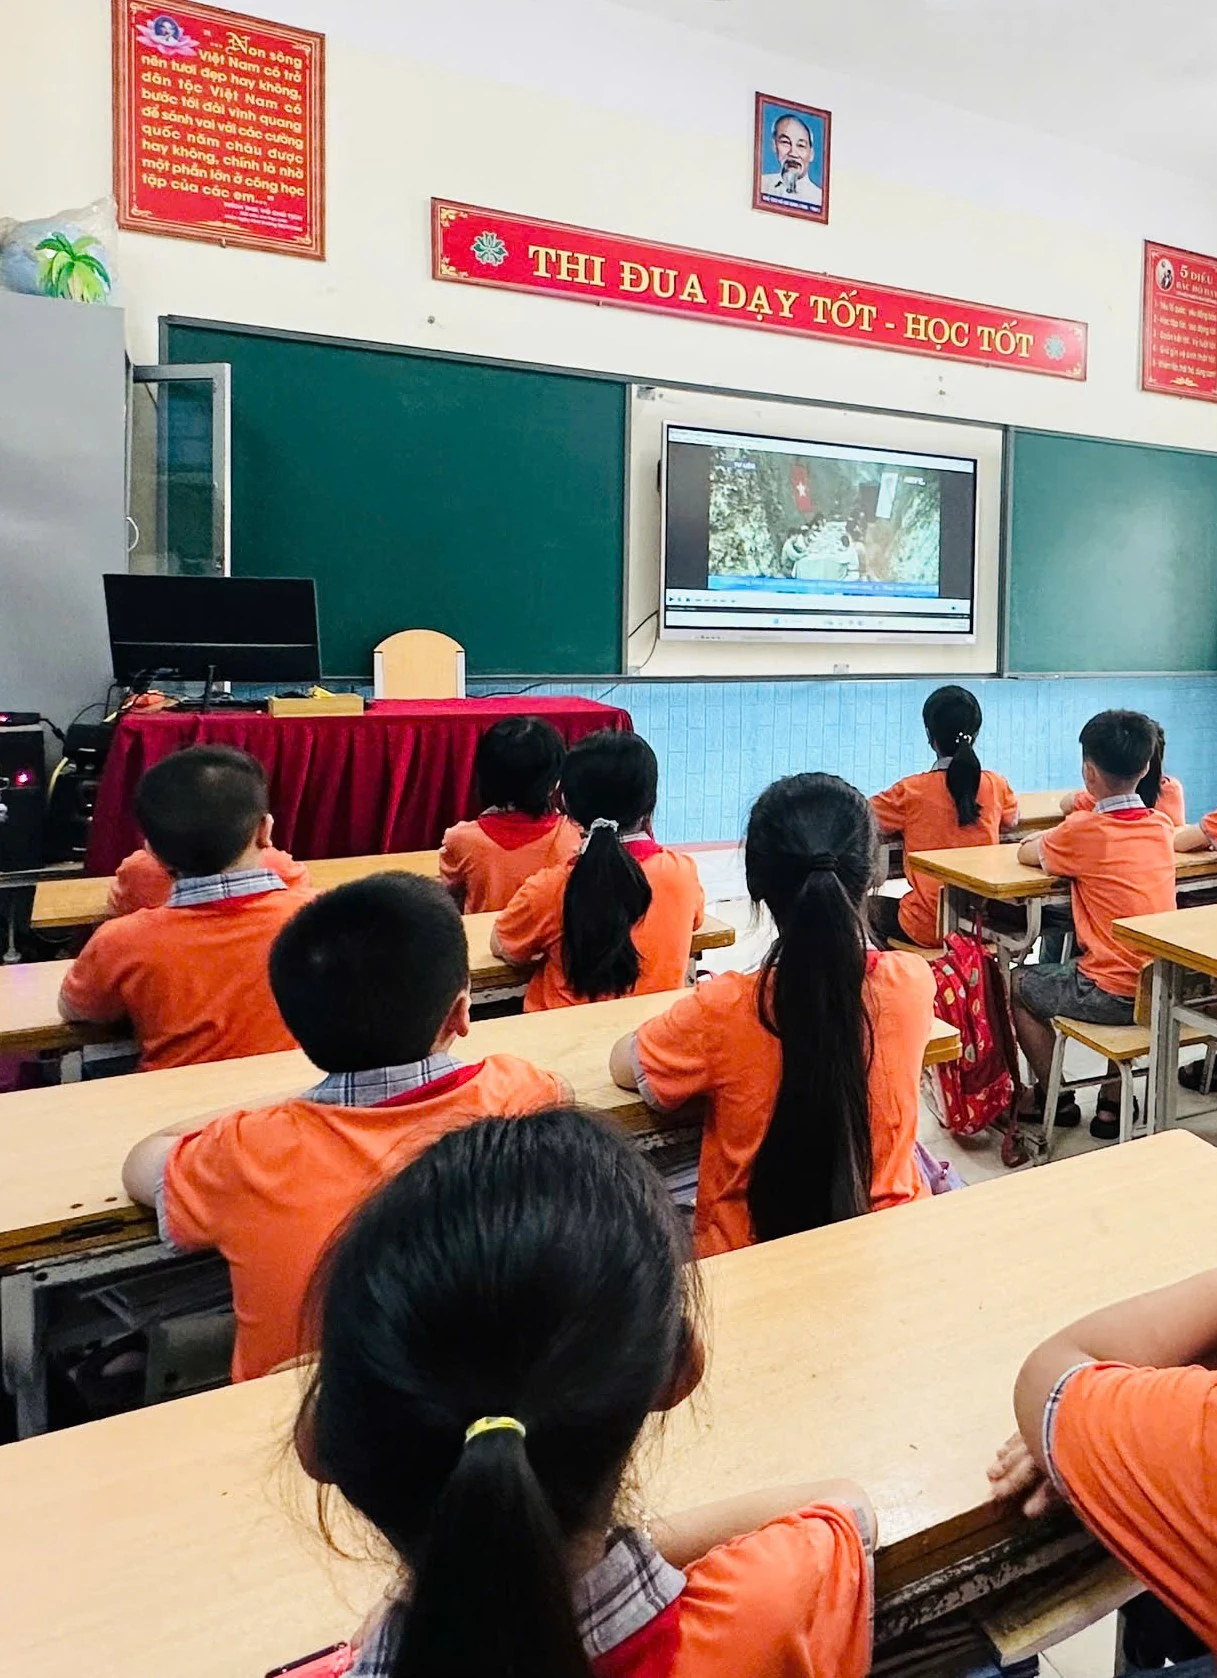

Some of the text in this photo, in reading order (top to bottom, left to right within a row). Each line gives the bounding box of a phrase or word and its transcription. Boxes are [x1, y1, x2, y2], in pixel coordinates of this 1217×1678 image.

[199, 49, 225, 67] Việt
[229, 57, 260, 73] Nam
[225, 31, 266, 58] Non
[269, 50, 302, 69] sông
[141, 54, 167, 68] nên
[231, 73, 255, 90] hay
[141, 72, 302, 115] dân tộc Việt Nam có
[141, 119, 181, 138] quốc
[161, 109, 193, 125] sánh
[195, 116, 215, 130] vai
[238, 126, 263, 140] các
[259, 114, 302, 133] quang
[142, 139, 168, 155] hay
[223, 153, 259, 172] chính
[142, 157, 169, 172] một
[281, 180, 304, 197] học
[142, 173, 167, 189] tập
[170, 178, 199, 193] của
[202, 183, 230, 198] các
[1179, 264, 1189, 279] 5
[528, 245, 605, 287] THI
[619, 260, 707, 303] ĐUA
[719, 278, 799, 321] DẠY
[810, 290, 877, 332] TỐT
[904, 312, 969, 350] HỌC
[977, 320, 1033, 358] TỐT
